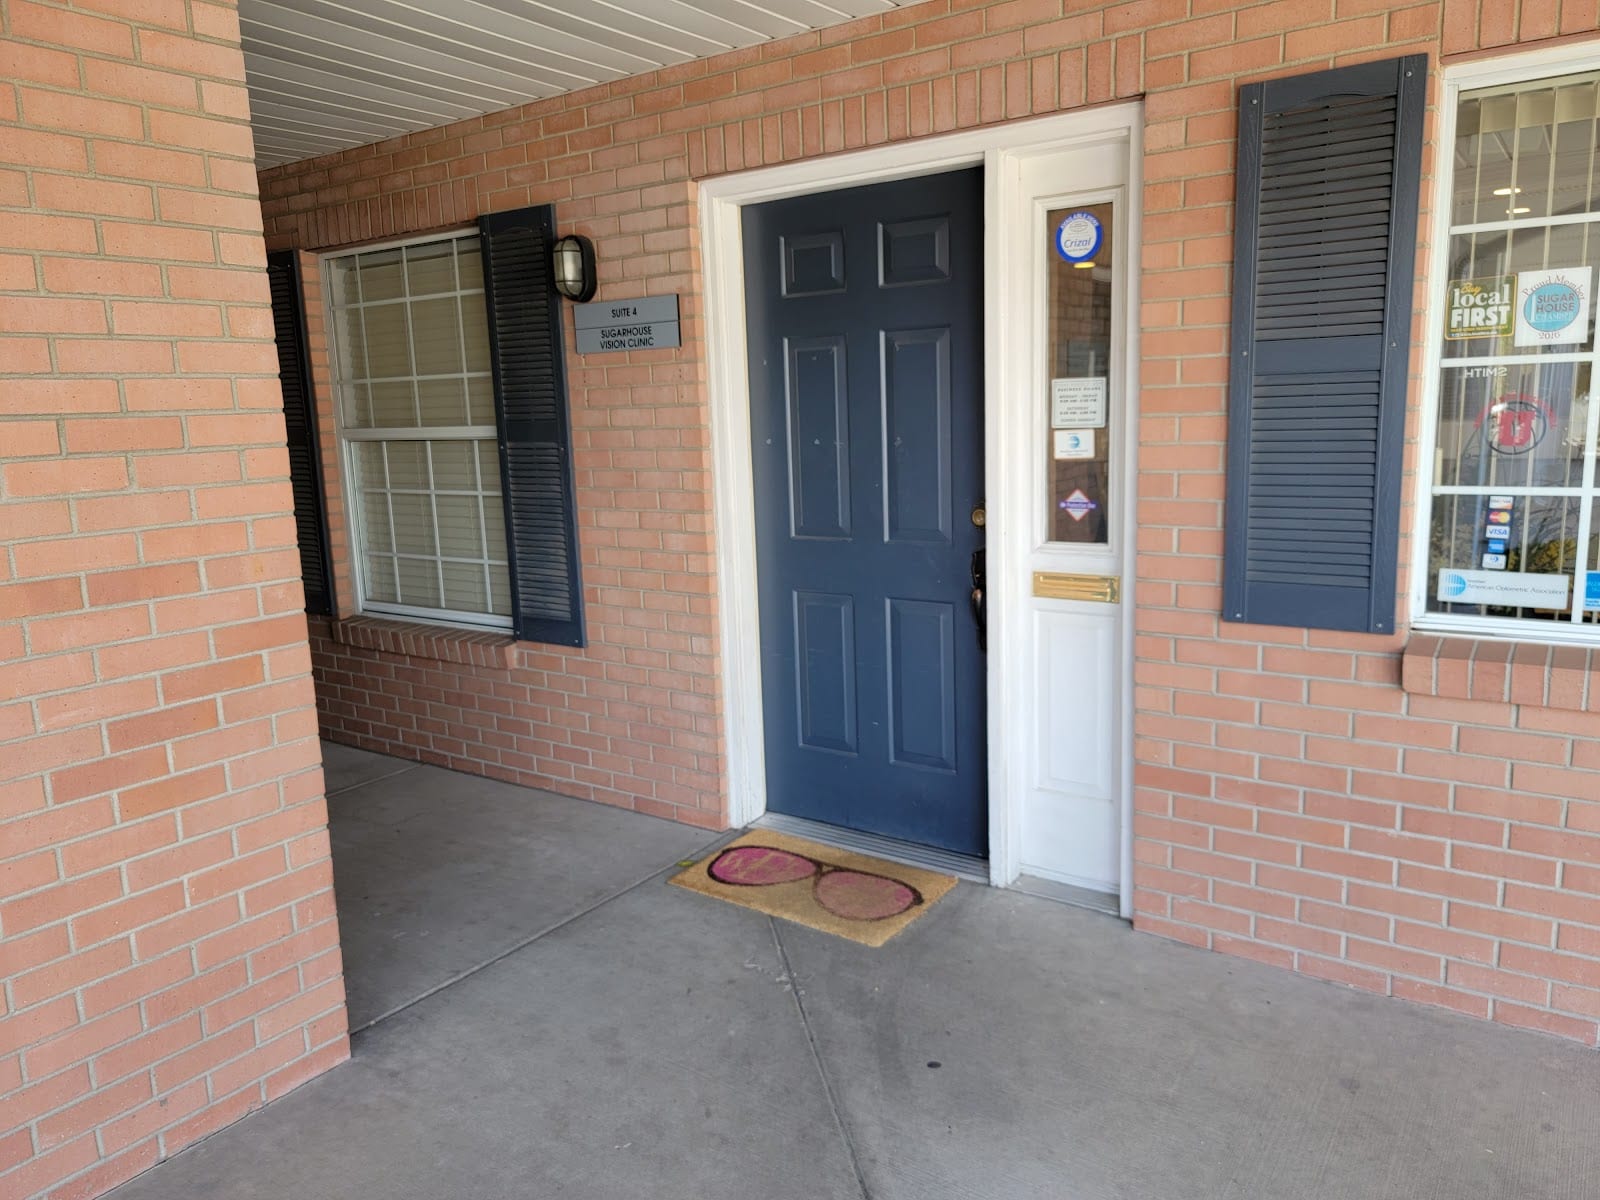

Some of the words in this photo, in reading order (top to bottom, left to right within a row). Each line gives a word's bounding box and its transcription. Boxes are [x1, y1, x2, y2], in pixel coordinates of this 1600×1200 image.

[1063, 237, 1092, 249] Crizal
[1461, 282, 1482, 296] Buy
[1522, 275, 1552, 297] Proud
[1555, 274, 1585, 300] Member
[1452, 284, 1511, 308] local
[1537, 293, 1575, 304] SUGAR
[611, 308, 631, 318] SUITE
[632, 307, 637, 316] 4
[1536, 302, 1575, 313] HOUSE
[1451, 305, 1511, 328] FIRST
[601, 326, 652, 339] SUGARHOUSE
[1538, 332, 1561, 341] 2016
[600, 340, 626, 350] VISION
[627, 337, 654, 348] CLINIC
[1488, 528, 1508, 536] VISA
